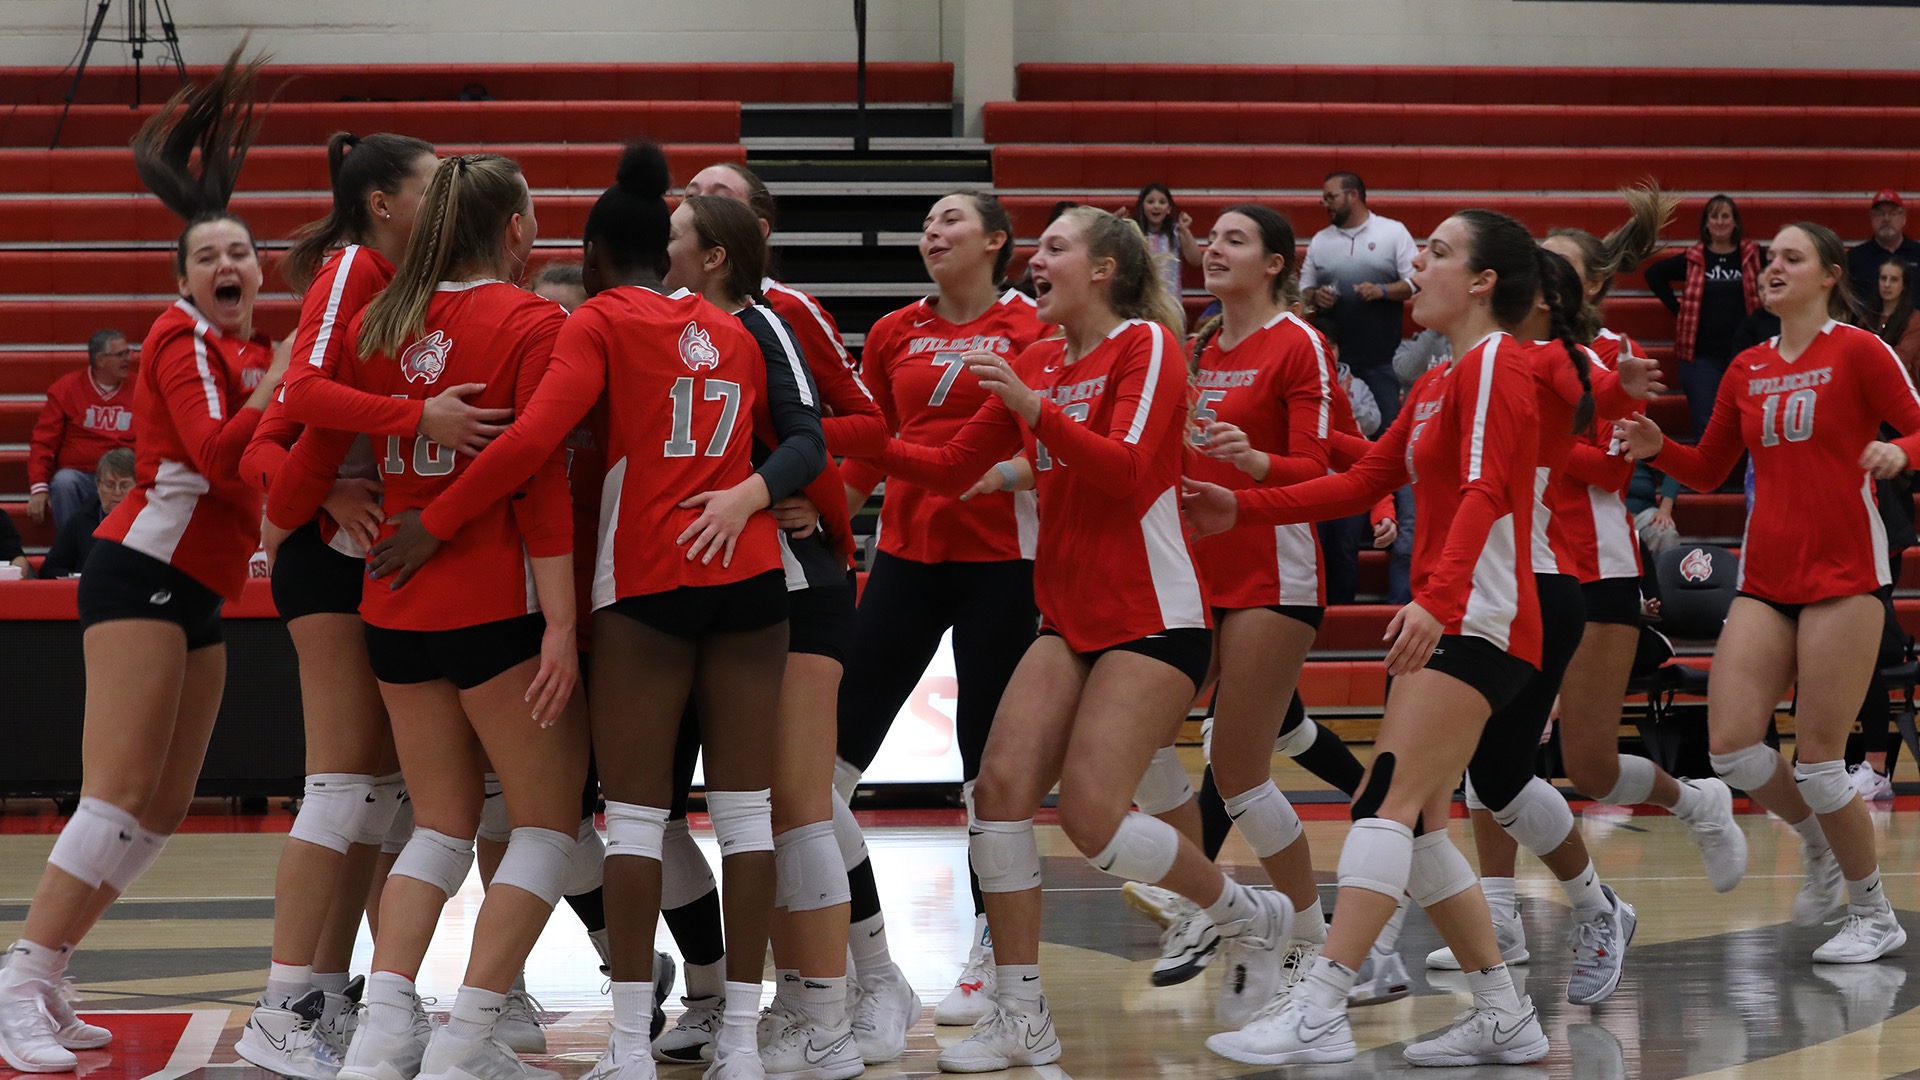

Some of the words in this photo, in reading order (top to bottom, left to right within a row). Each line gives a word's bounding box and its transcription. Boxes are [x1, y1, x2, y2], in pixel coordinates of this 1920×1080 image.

[908, 335, 1011, 355] WILDCATS
[928, 352, 965, 407] 7
[1197, 369, 1259, 388] ILDCATS
[1748, 367, 1833, 396] WILDCATS
[664, 377, 740, 457] 17
[1191, 390, 1227, 446] 5
[1761, 388, 1818, 447] 10
